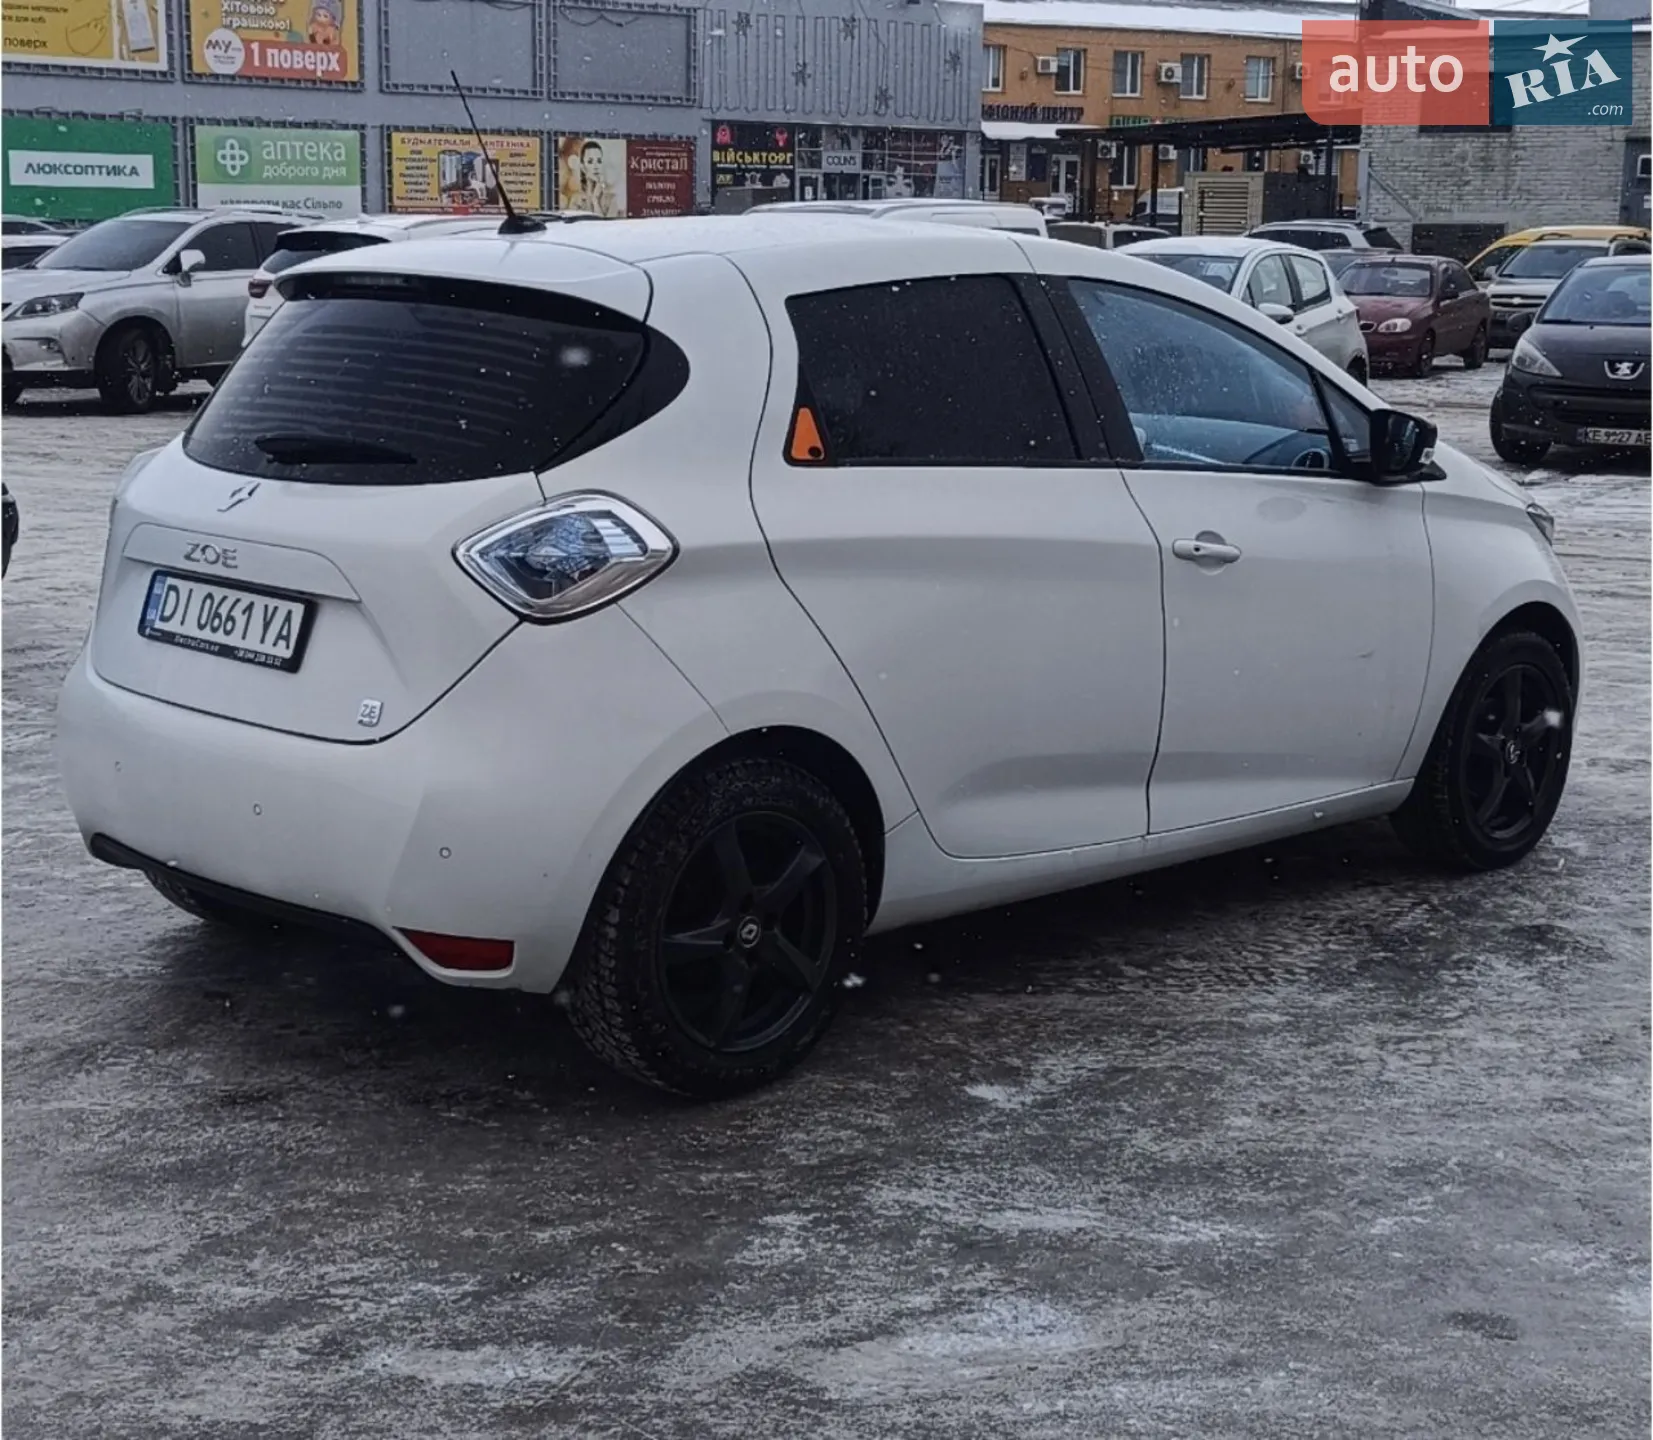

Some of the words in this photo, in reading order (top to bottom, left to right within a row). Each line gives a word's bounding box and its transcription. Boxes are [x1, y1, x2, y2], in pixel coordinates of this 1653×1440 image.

[4, 37, 48, 49] поверх
[250, 42, 260, 67] 1
[266, 47, 340, 77] поверх
[1042, 106, 1084, 122] ЦЕНТР
[262, 140, 346, 162] аптека
[712, 148, 793, 164] ВІЙСЬКТОРГ
[24, 161, 140, 178] ЛЮКСОПТИКА
[262, 162, 319, 178] доброго
[322, 167, 347, 180] дня
[630, 156, 688, 172] Кристал
[304, 197, 343, 209] Сільпо
[183, 541, 239, 569] ZOE
[158, 584, 193, 626] DI
[197, 592, 255, 641] 0661
[259, 604, 293, 650] YA
